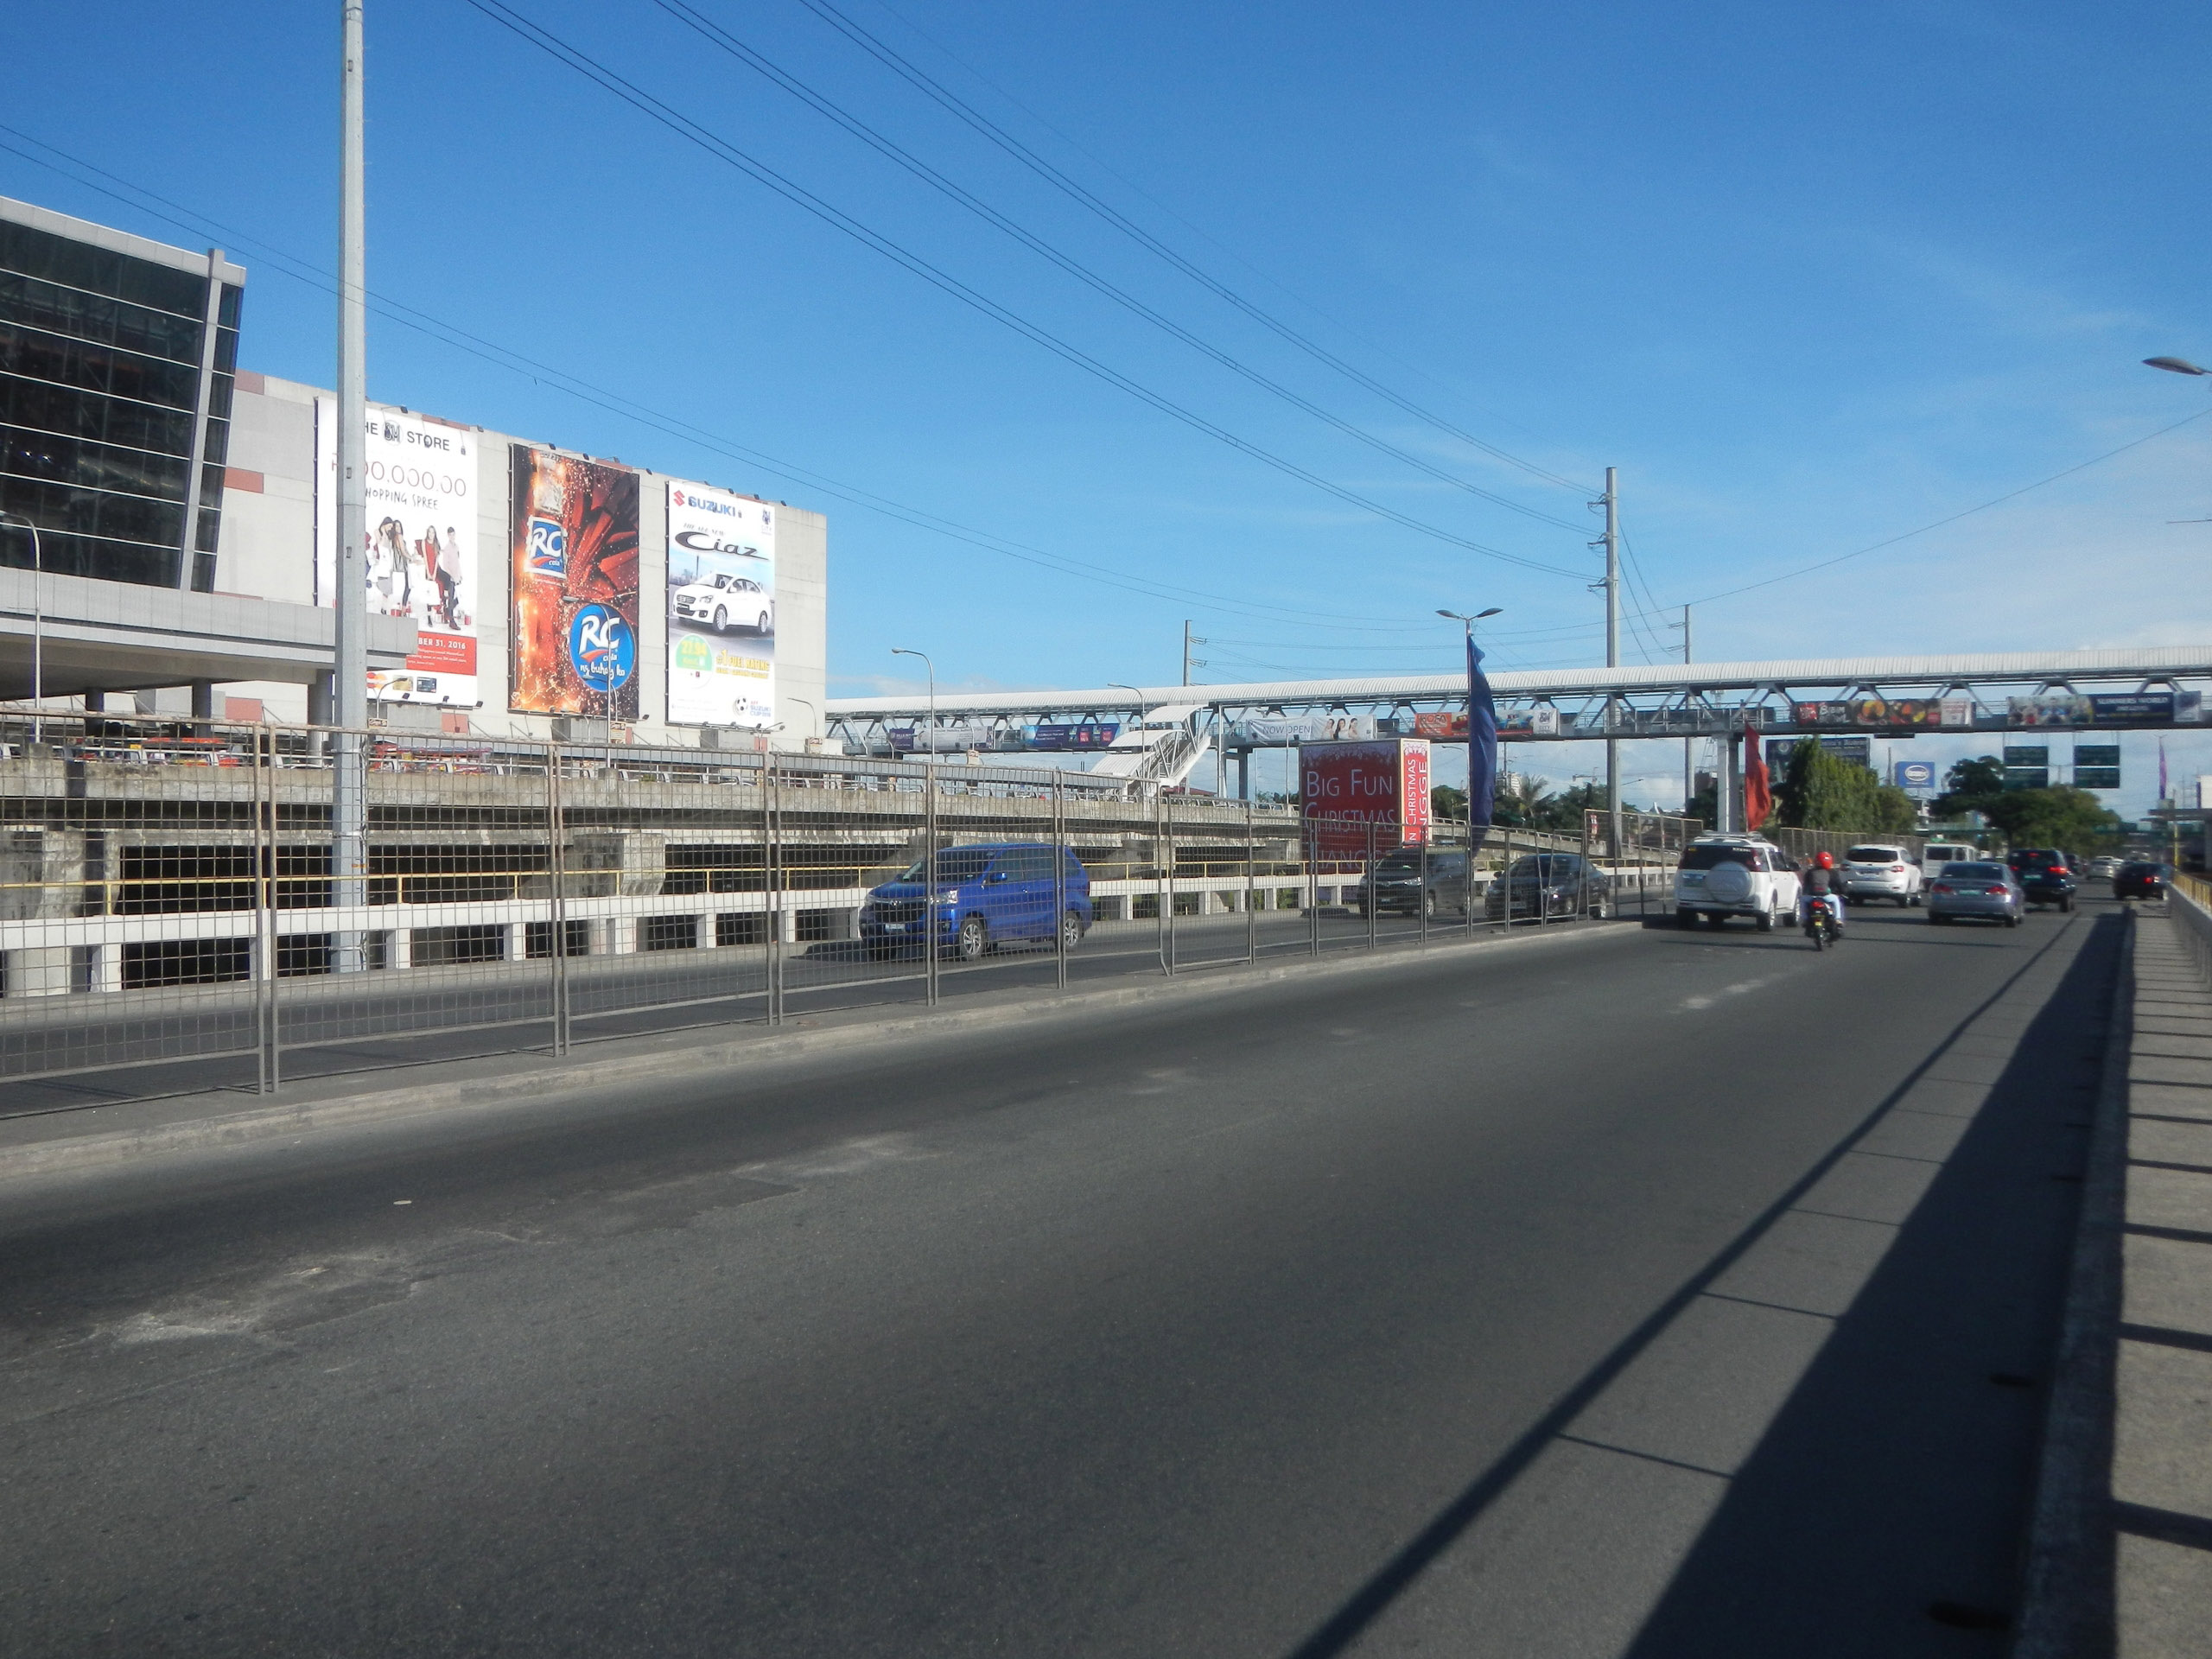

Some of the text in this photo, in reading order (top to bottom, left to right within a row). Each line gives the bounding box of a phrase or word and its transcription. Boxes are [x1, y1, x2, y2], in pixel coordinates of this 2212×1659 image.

[364, 422, 378, 435] HE
[407, 431, 450, 451] STORE
[365, 487, 439, 510] HOPPING SPREE
[688, 496, 736, 517] SUZUKI
[529, 527, 562, 559] RC
[675, 531, 770, 561] Ciaz
[418, 637, 434, 646] BER
[448, 641, 466, 650] 2016
[578, 614, 621, 656] RC
[616, 664, 626, 677] ko
[1262, 726, 1284, 734] NOW
